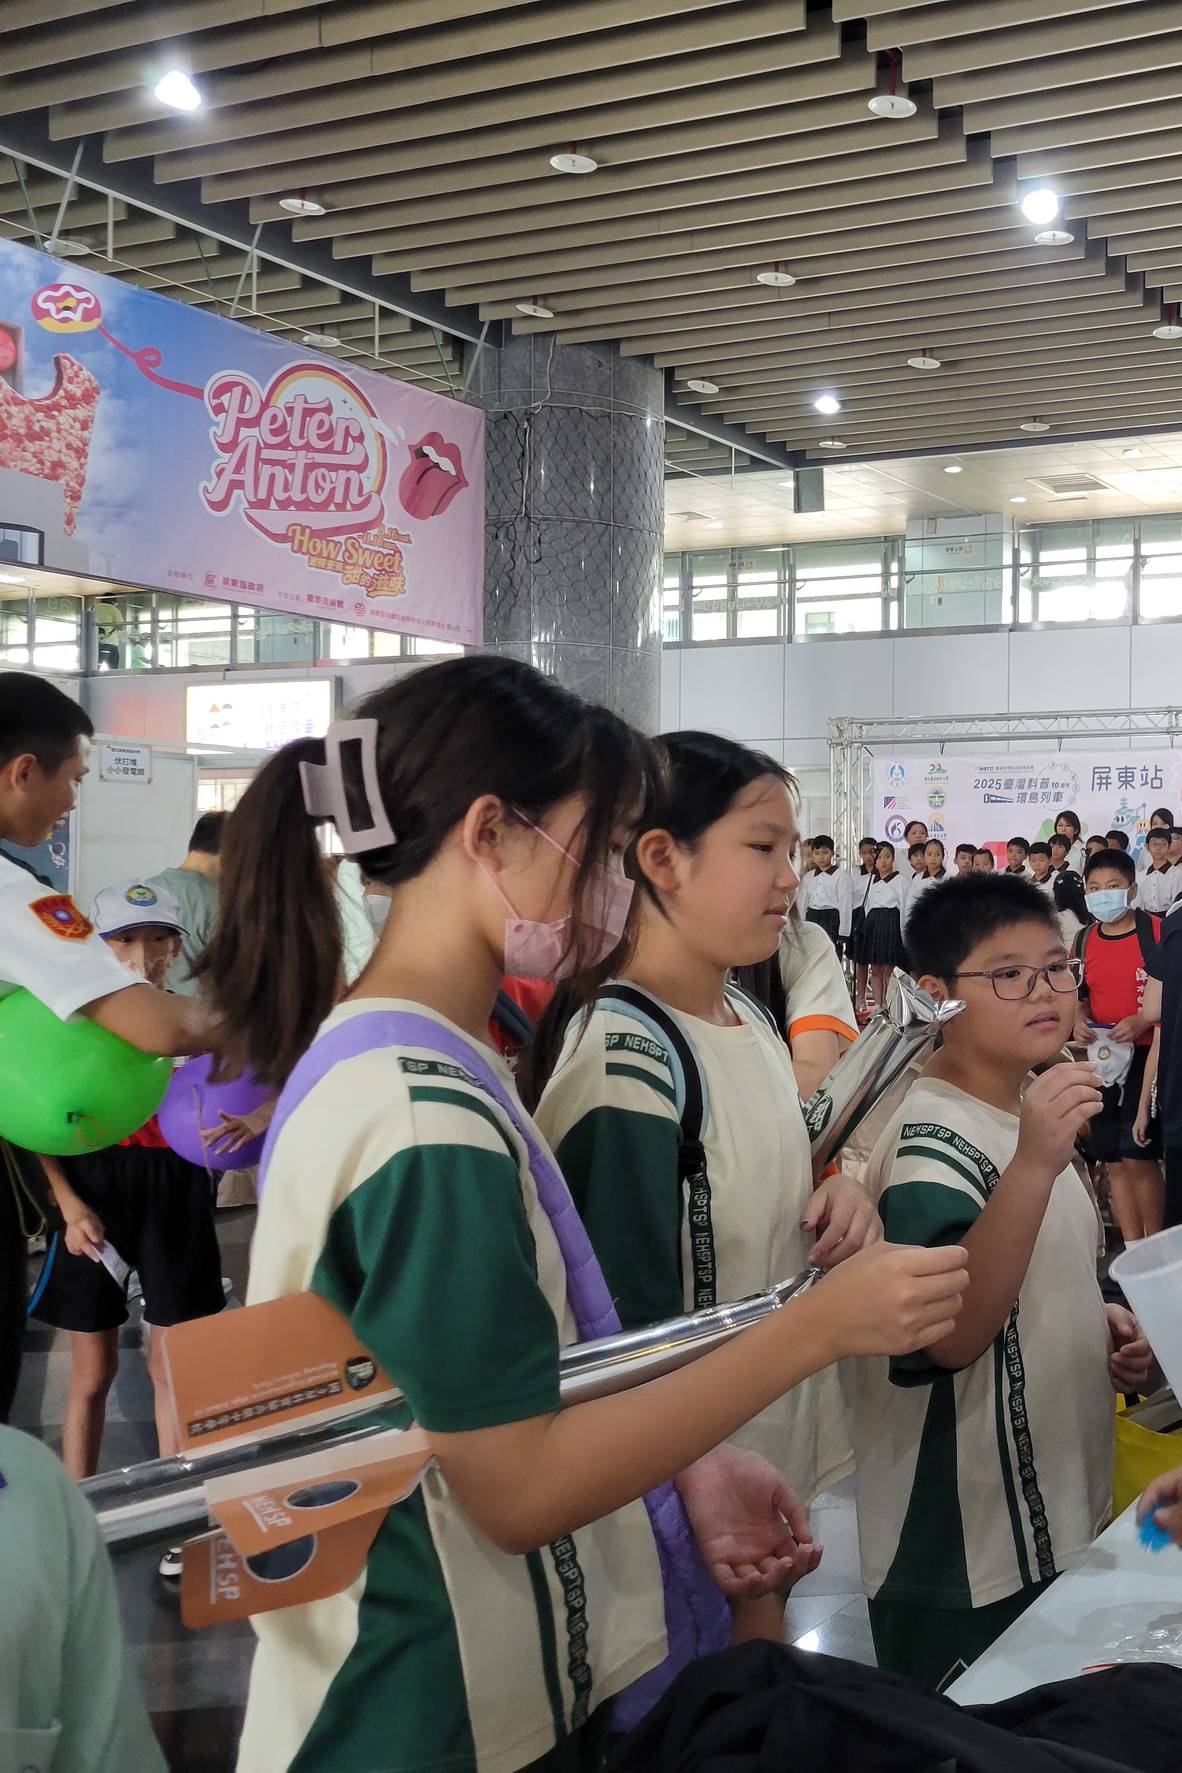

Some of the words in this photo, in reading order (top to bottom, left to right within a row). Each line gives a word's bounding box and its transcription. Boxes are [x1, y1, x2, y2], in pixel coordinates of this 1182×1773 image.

[209, 375, 364, 451] Peter
[203, 436, 374, 506] Anton
[287, 523, 342, 561] How
[343, 536, 404, 574] Sweet
[1016, 791, 1064, 804] 環島列車
[1091, 765, 1163, 792] 屏東站
[952, 1135, 993, 1173] NEHSPTSP
